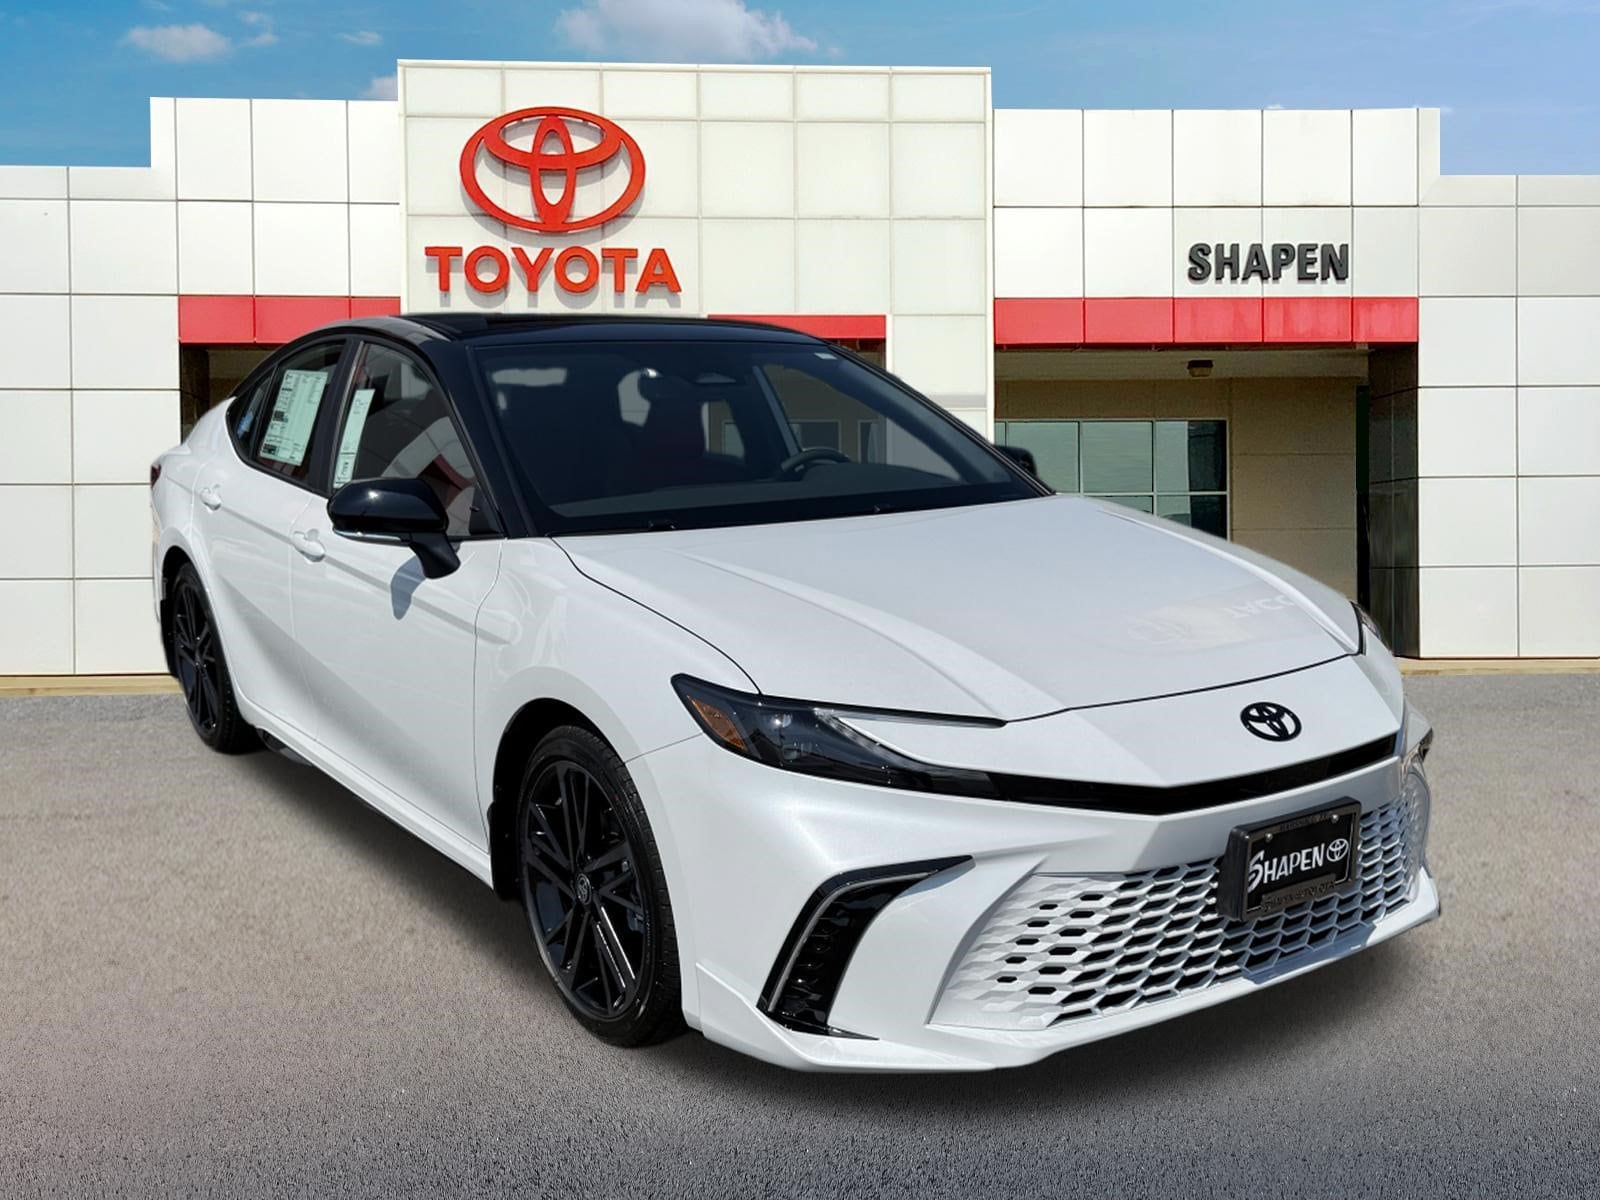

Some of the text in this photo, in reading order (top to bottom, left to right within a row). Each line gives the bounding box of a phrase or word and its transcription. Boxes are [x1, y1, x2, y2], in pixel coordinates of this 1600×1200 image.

[424, 245, 682, 294] TOYOTA
[1188, 242, 1349, 281] SHAPEN
[1247, 843, 1325, 895] SHAPEN
